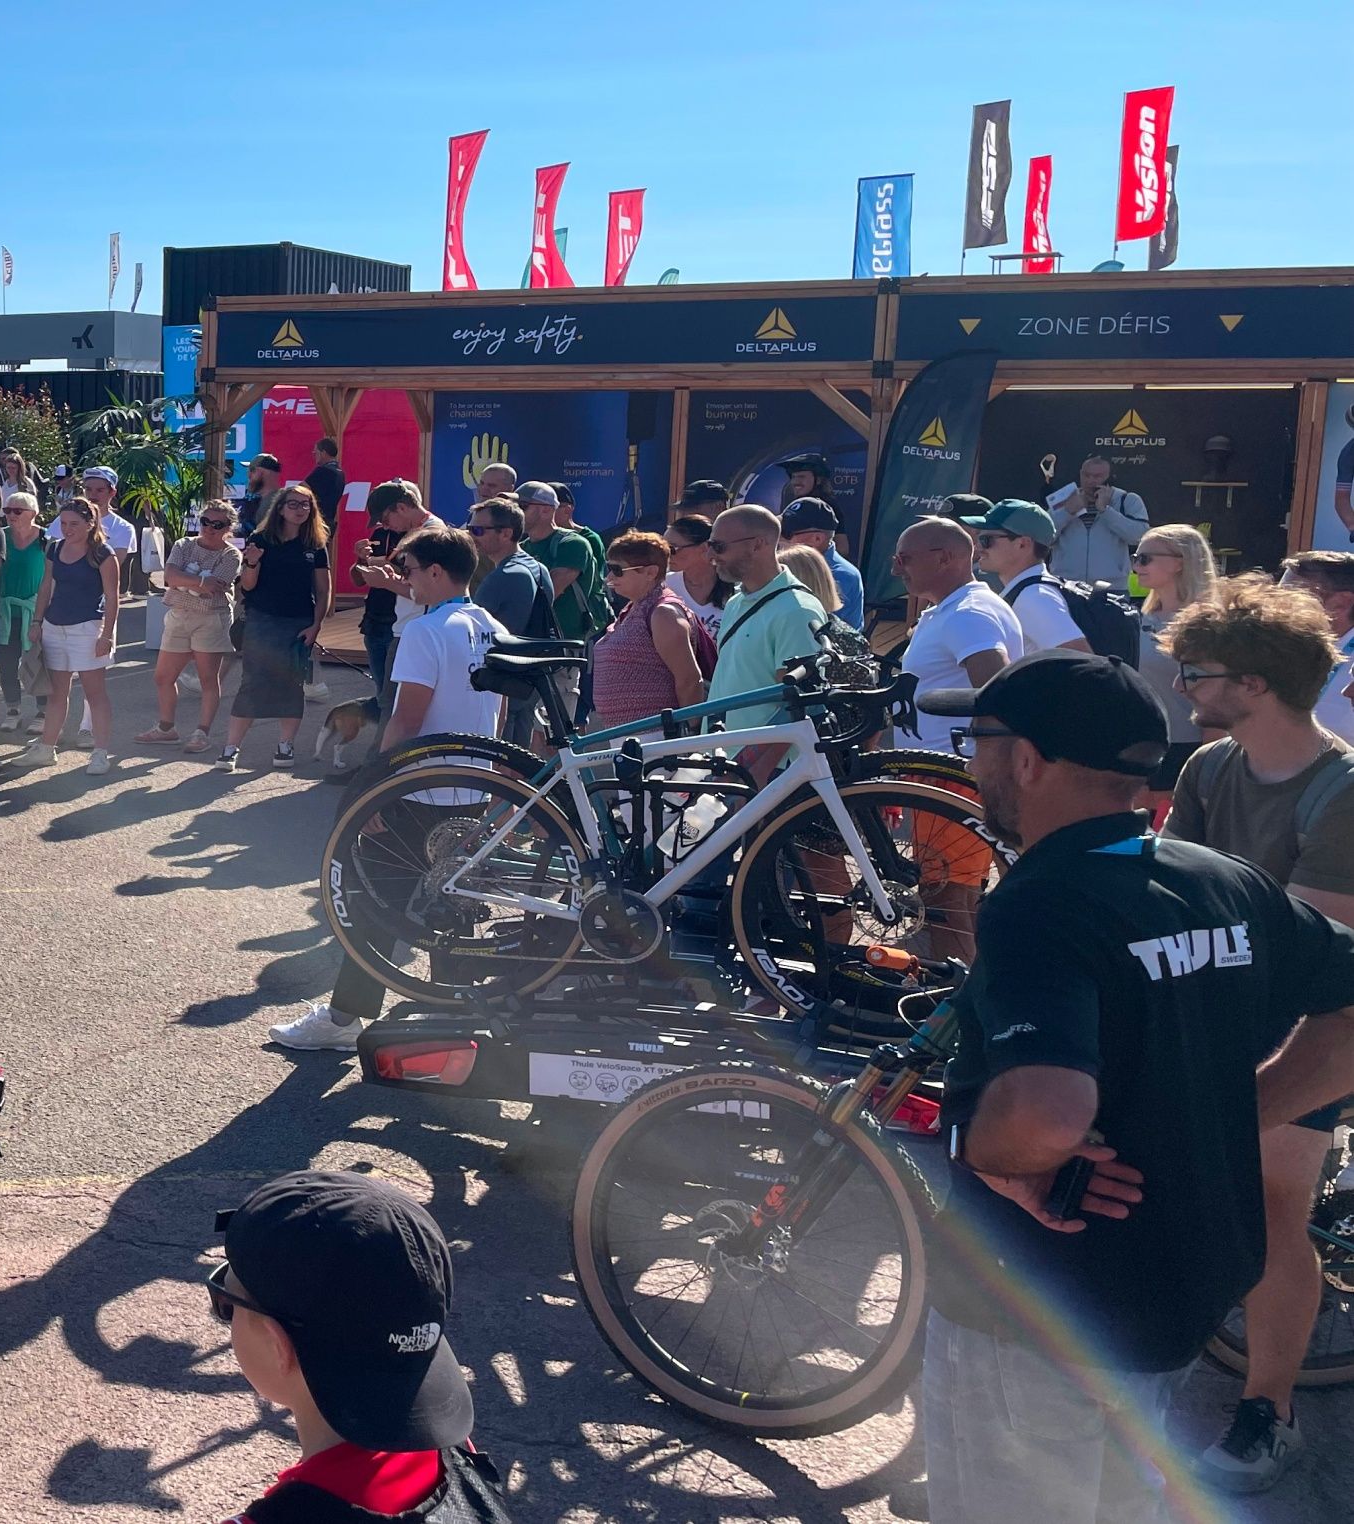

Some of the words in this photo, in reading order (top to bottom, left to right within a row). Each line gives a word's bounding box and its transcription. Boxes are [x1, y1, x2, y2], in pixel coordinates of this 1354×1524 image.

[1017, 317, 1091, 336] ZONE
[1098, 311, 1171, 335] DÉFIS
[452, 322, 506, 355] enjoy
[257, 349, 320, 360] DELTAPLUS
[735, 341, 817, 355] DELTAPLUS
[262, 398, 318, 415] ME
[449, 409, 493, 418] chainless
[705, 410, 758, 421] bunny-up
[1095, 437, 1166, 448] DELTAPLUS
[903, 445, 961, 461] DELTAPLUS
[563, 468, 615, 477] superman
[833, 475, 859, 485] OTB
[560, 845, 583, 910] rova
[1127, 924, 1252, 981] THULE
[628, 1041, 664, 1053] THULE
[571, 1059, 594, 1069] Thule
[596, 1062, 642, 1074] VeloSpace
[644, 1066, 656, 1074] XT
[685, 1077, 757, 1090] BARZO
[412, 1323, 430, 1337] THE
[388, 1333, 429, 1347] NORTH
[397, 1345, 425, 1353] FACE
